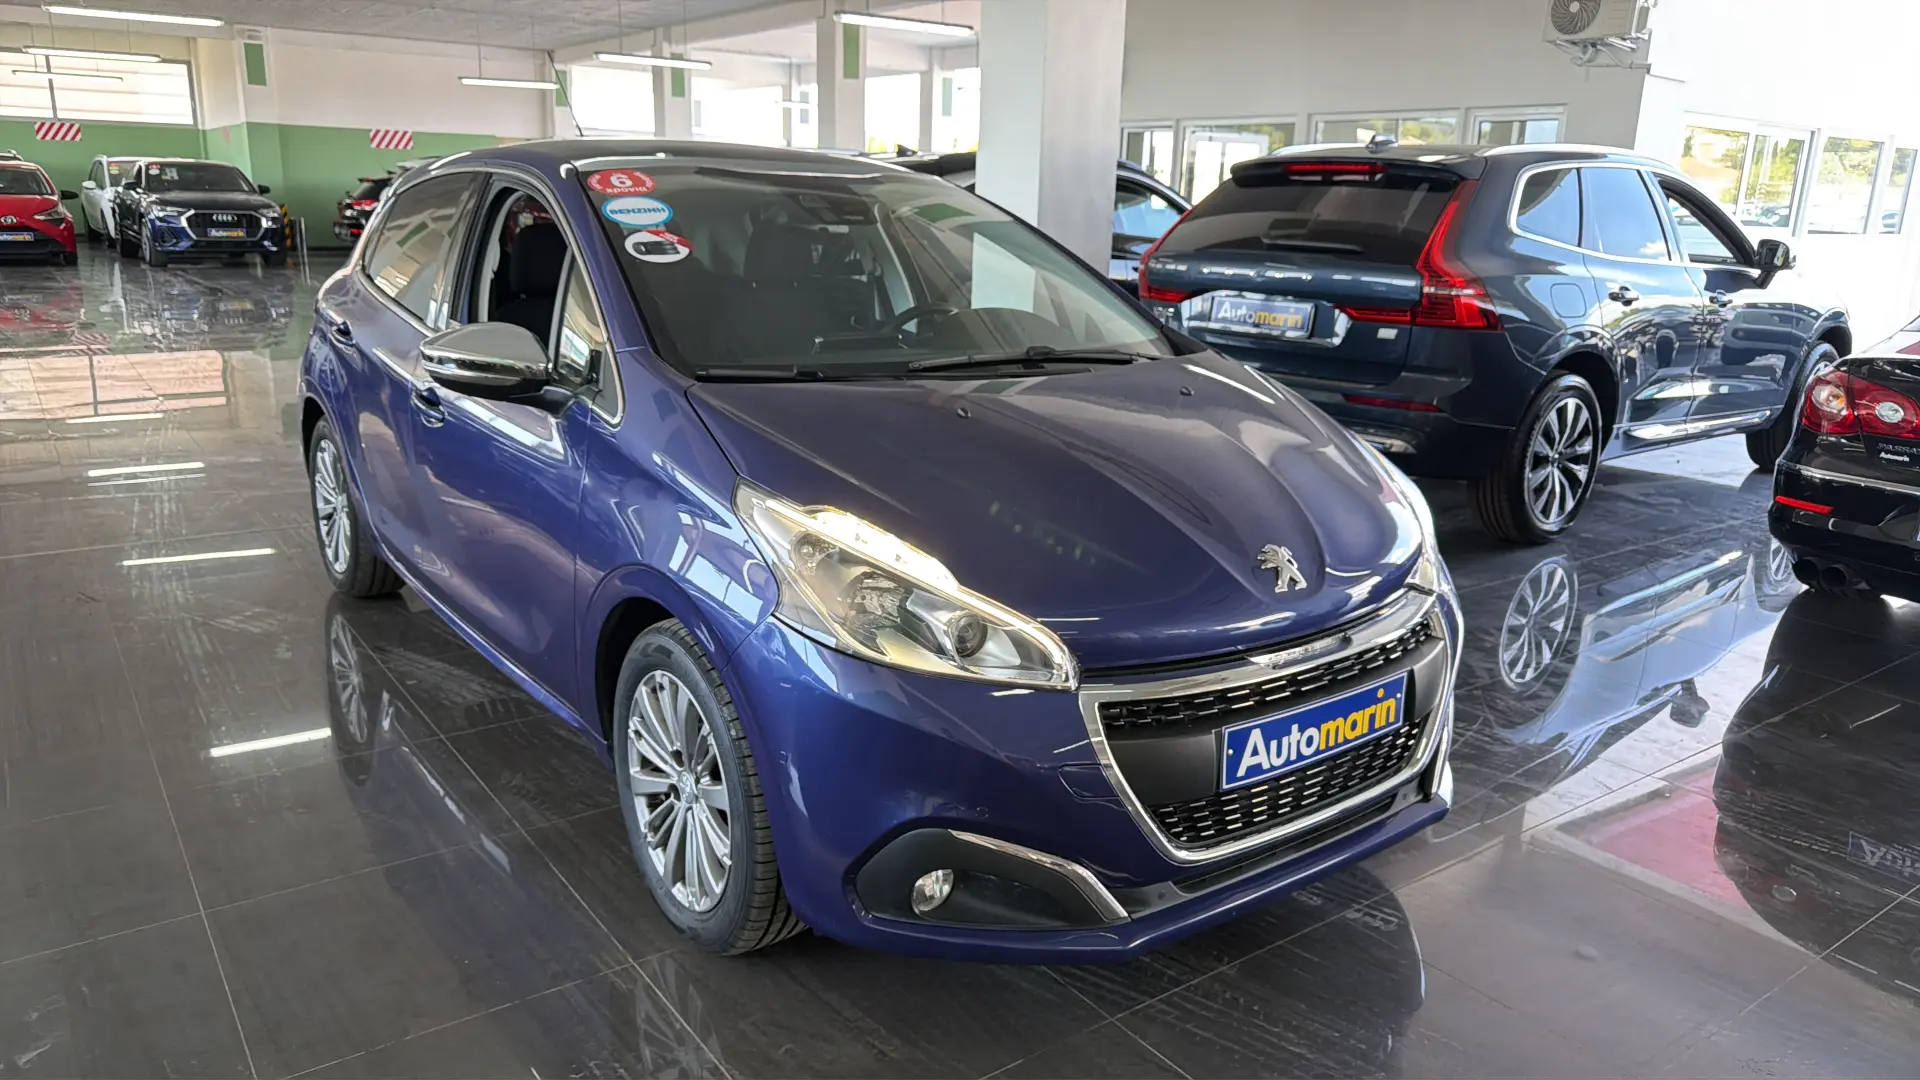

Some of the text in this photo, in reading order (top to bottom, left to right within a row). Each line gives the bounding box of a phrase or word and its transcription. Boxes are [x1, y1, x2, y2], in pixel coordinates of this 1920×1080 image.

[610, 172, 633, 188] 6
[1218, 301, 1303, 329] Automarin
[1236, 688, 1396, 777] Automarin
